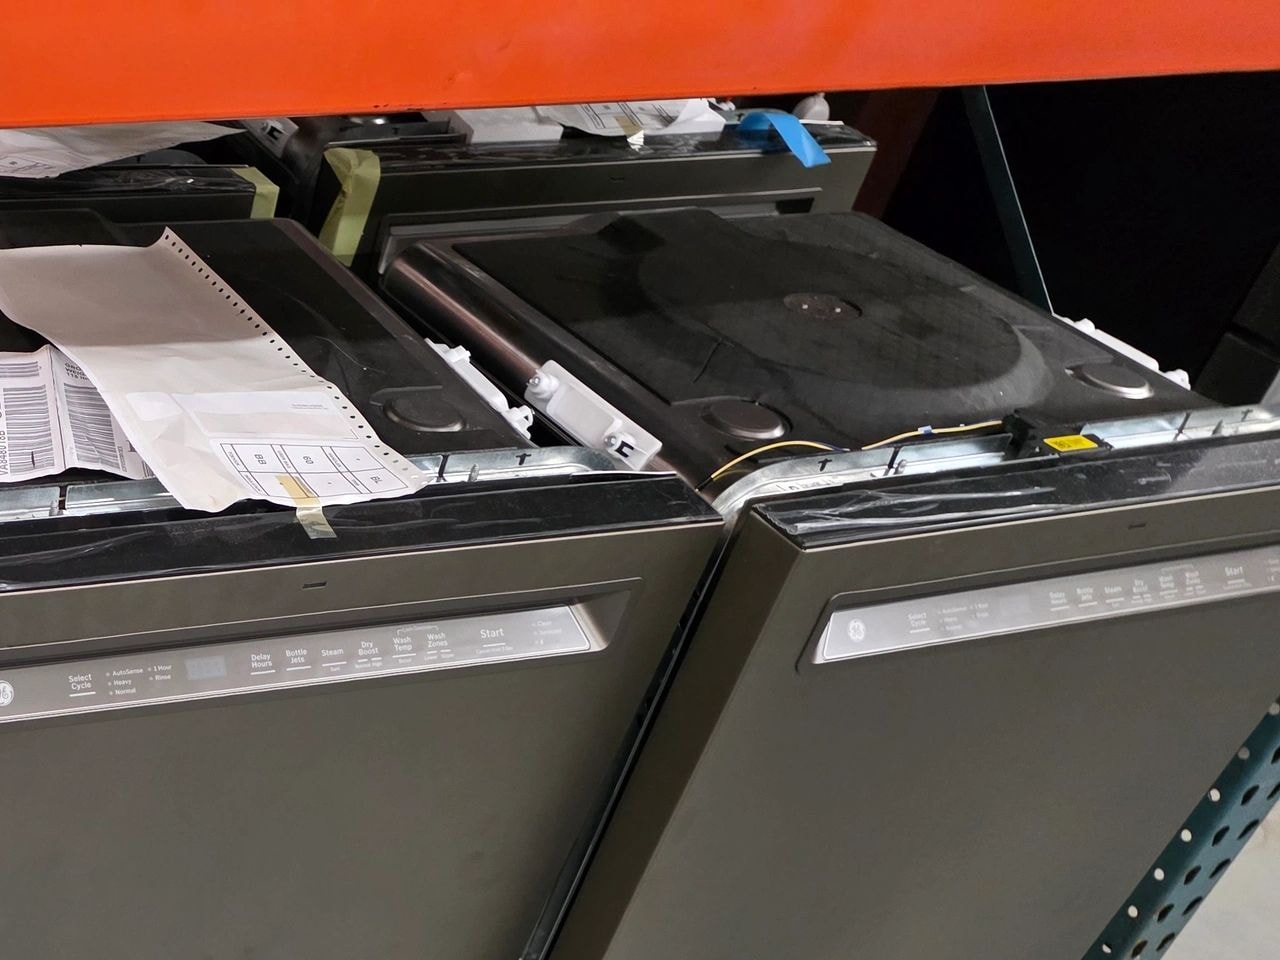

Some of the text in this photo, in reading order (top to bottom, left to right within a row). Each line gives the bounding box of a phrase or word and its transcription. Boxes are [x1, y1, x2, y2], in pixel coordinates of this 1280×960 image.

[426, 632, 446, 640] Wash
[480, 628, 504, 638] Start
[393, 636, 412, 644] Wash
[427, 640, 448, 648] Zones
[360, 641, 374, 650] Dry
[285, 648, 308, 657] Bottle
[321, 648, 344, 657] Steam
[358, 647, 380, 656] Boost
[251, 653, 271, 663] Delay
[290, 656, 305, 664] Jets
[158, 664, 172, 672] Hour
[251, 660, 273, 669] Hours
[112, 667, 144, 677] AutoSense
[68, 673, 93, 683] Select
[155, 673, 172, 681] Rinse
[71, 681, 92, 691] Cycle
[113, 678, 132, 687] Heavy
[115, 687, 137, 696] Normal
